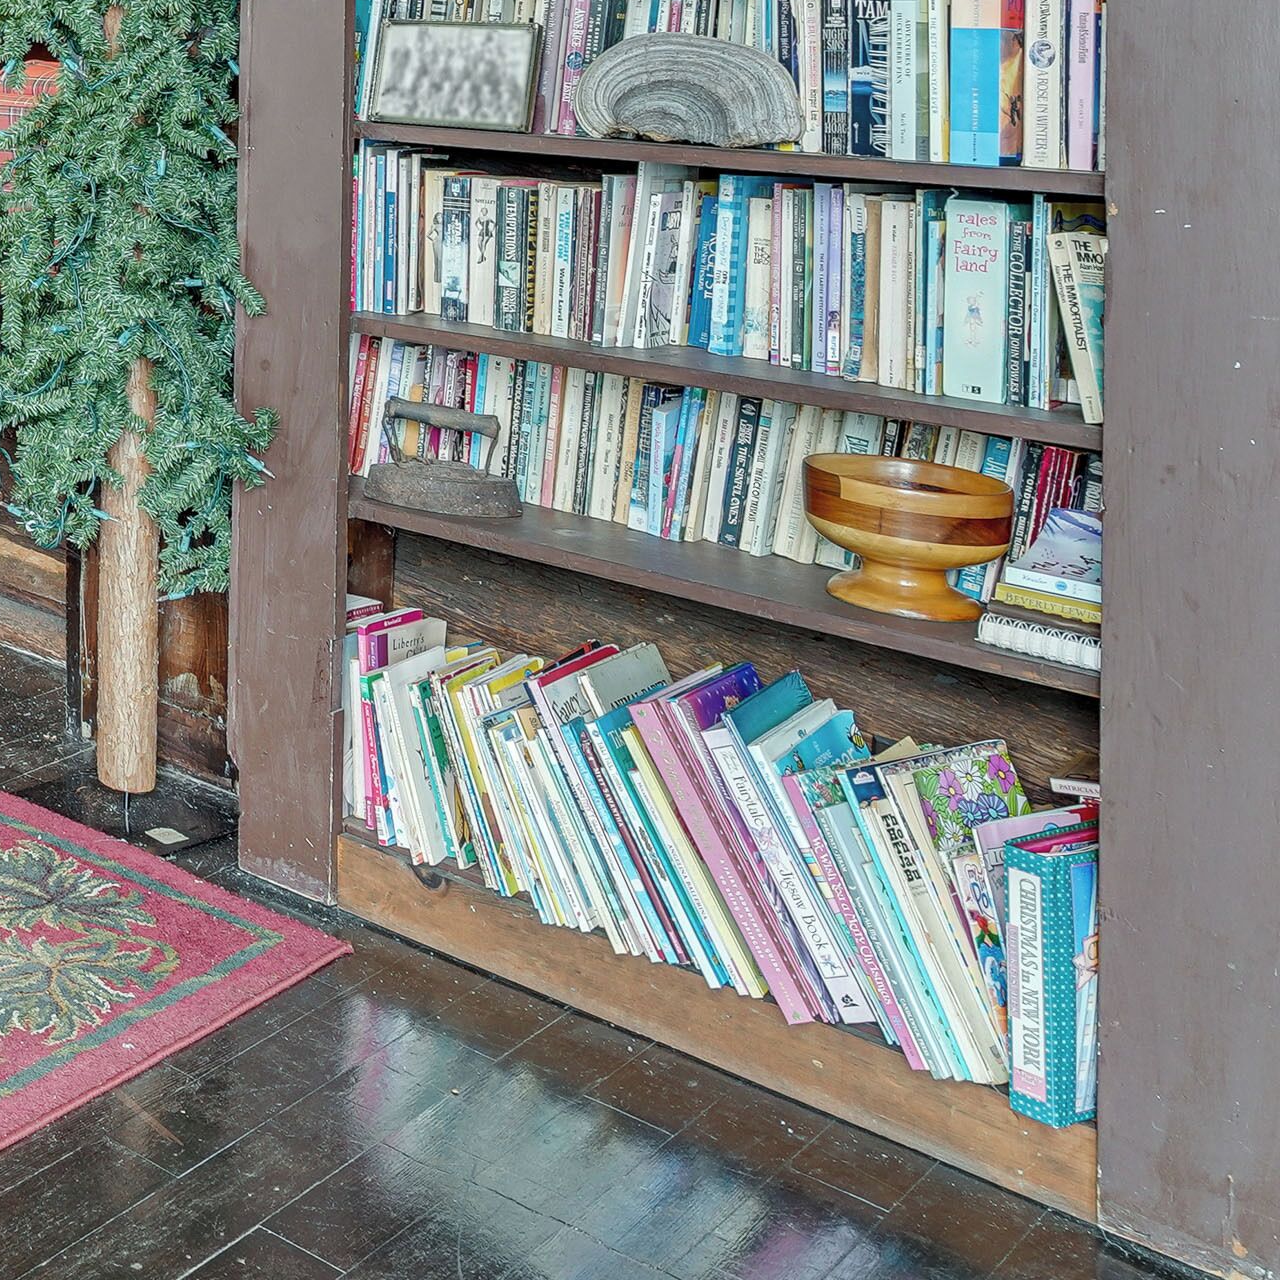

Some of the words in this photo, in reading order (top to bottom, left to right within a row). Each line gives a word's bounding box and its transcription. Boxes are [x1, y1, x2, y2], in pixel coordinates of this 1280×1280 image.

[547, 11, 557, 29] with
[572, 7, 586, 30] ANNE
[544, 30, 555, 55] Morrie
[571, 30, 584, 48] RICE
[822, 29, 848, 40] NIGHT
[826, 40, 845, 52] SINS
[904, 19, 912, 66] ADVENTURES
[905, 68, 912, 79] OF
[930, 52, 938, 75] SCHOOL
[930, 78, 938, 96] YEAR
[1035, 79, 1048, 103] ROSE
[810, 109, 818, 121] Lee
[930, 97, 938, 114] EVER
[1035, 104, 1048, 114] IN
[1035, 115, 1048, 151] WINTER
[505, 203, 517, 260] TEMPTATIONS
[956, 213, 998, 226] Tales
[962, 228, 992, 240] from
[1013, 235, 1021, 251] THE
[1072, 240, 1092, 252] THE
[557, 243, 563, 259] ON
[954, 240, 998, 262] Fairy
[955, 256, 988, 273] land
[1054, 265, 1062, 276] Alan
[1061, 263, 1073, 283] THE
[1009, 251, 1025, 335] COLLECTOR
[1056, 276, 1066, 303] Harrington
[1065, 285, 1087, 353] IMMORTALIST
[1009, 336, 1019, 358] JOHN
[1009, 360, 1019, 392] FOWLES
[744, 423, 754, 444] FRITZ
[736, 446, 749, 465] THE
[731, 466, 746, 497] SINFUL
[1022, 472, 1035, 511] YONDER
[727, 498, 743, 525] ONES
[1005, 592, 1058, 612] BEVERLY
[1060, 606, 1100, 621] LEWIS
[393, 634, 425, 652] Liberty's
[592, 767, 607, 789] MEET
[601, 787, 626, 828] SAMANTHA
[730, 772, 770, 829] Fairytale
[811, 834, 828, 854] We
[818, 852, 839, 881] Wish
[667, 842, 690, 881] ANGELINA
[685, 880, 709, 921] BALLERINA
[830, 879, 848, 903] You
[722, 865, 739, 890] FAIRY
[764, 947, 782, 973] GUIDE
[774, 863, 811, 914] Jigsaw
[800, 911, 831, 954] Book
[724, 887, 742, 913] BEING
[741, 920, 767, 961] PRINCESS
[842, 909, 867, 946] Merry
[1018, 878, 1040, 972] CHRISTMAS
[859, 943, 895, 1006] Christmas
[1020, 982, 1040, 1023] NEW
[1022, 1022, 1041, 1072] YORK
